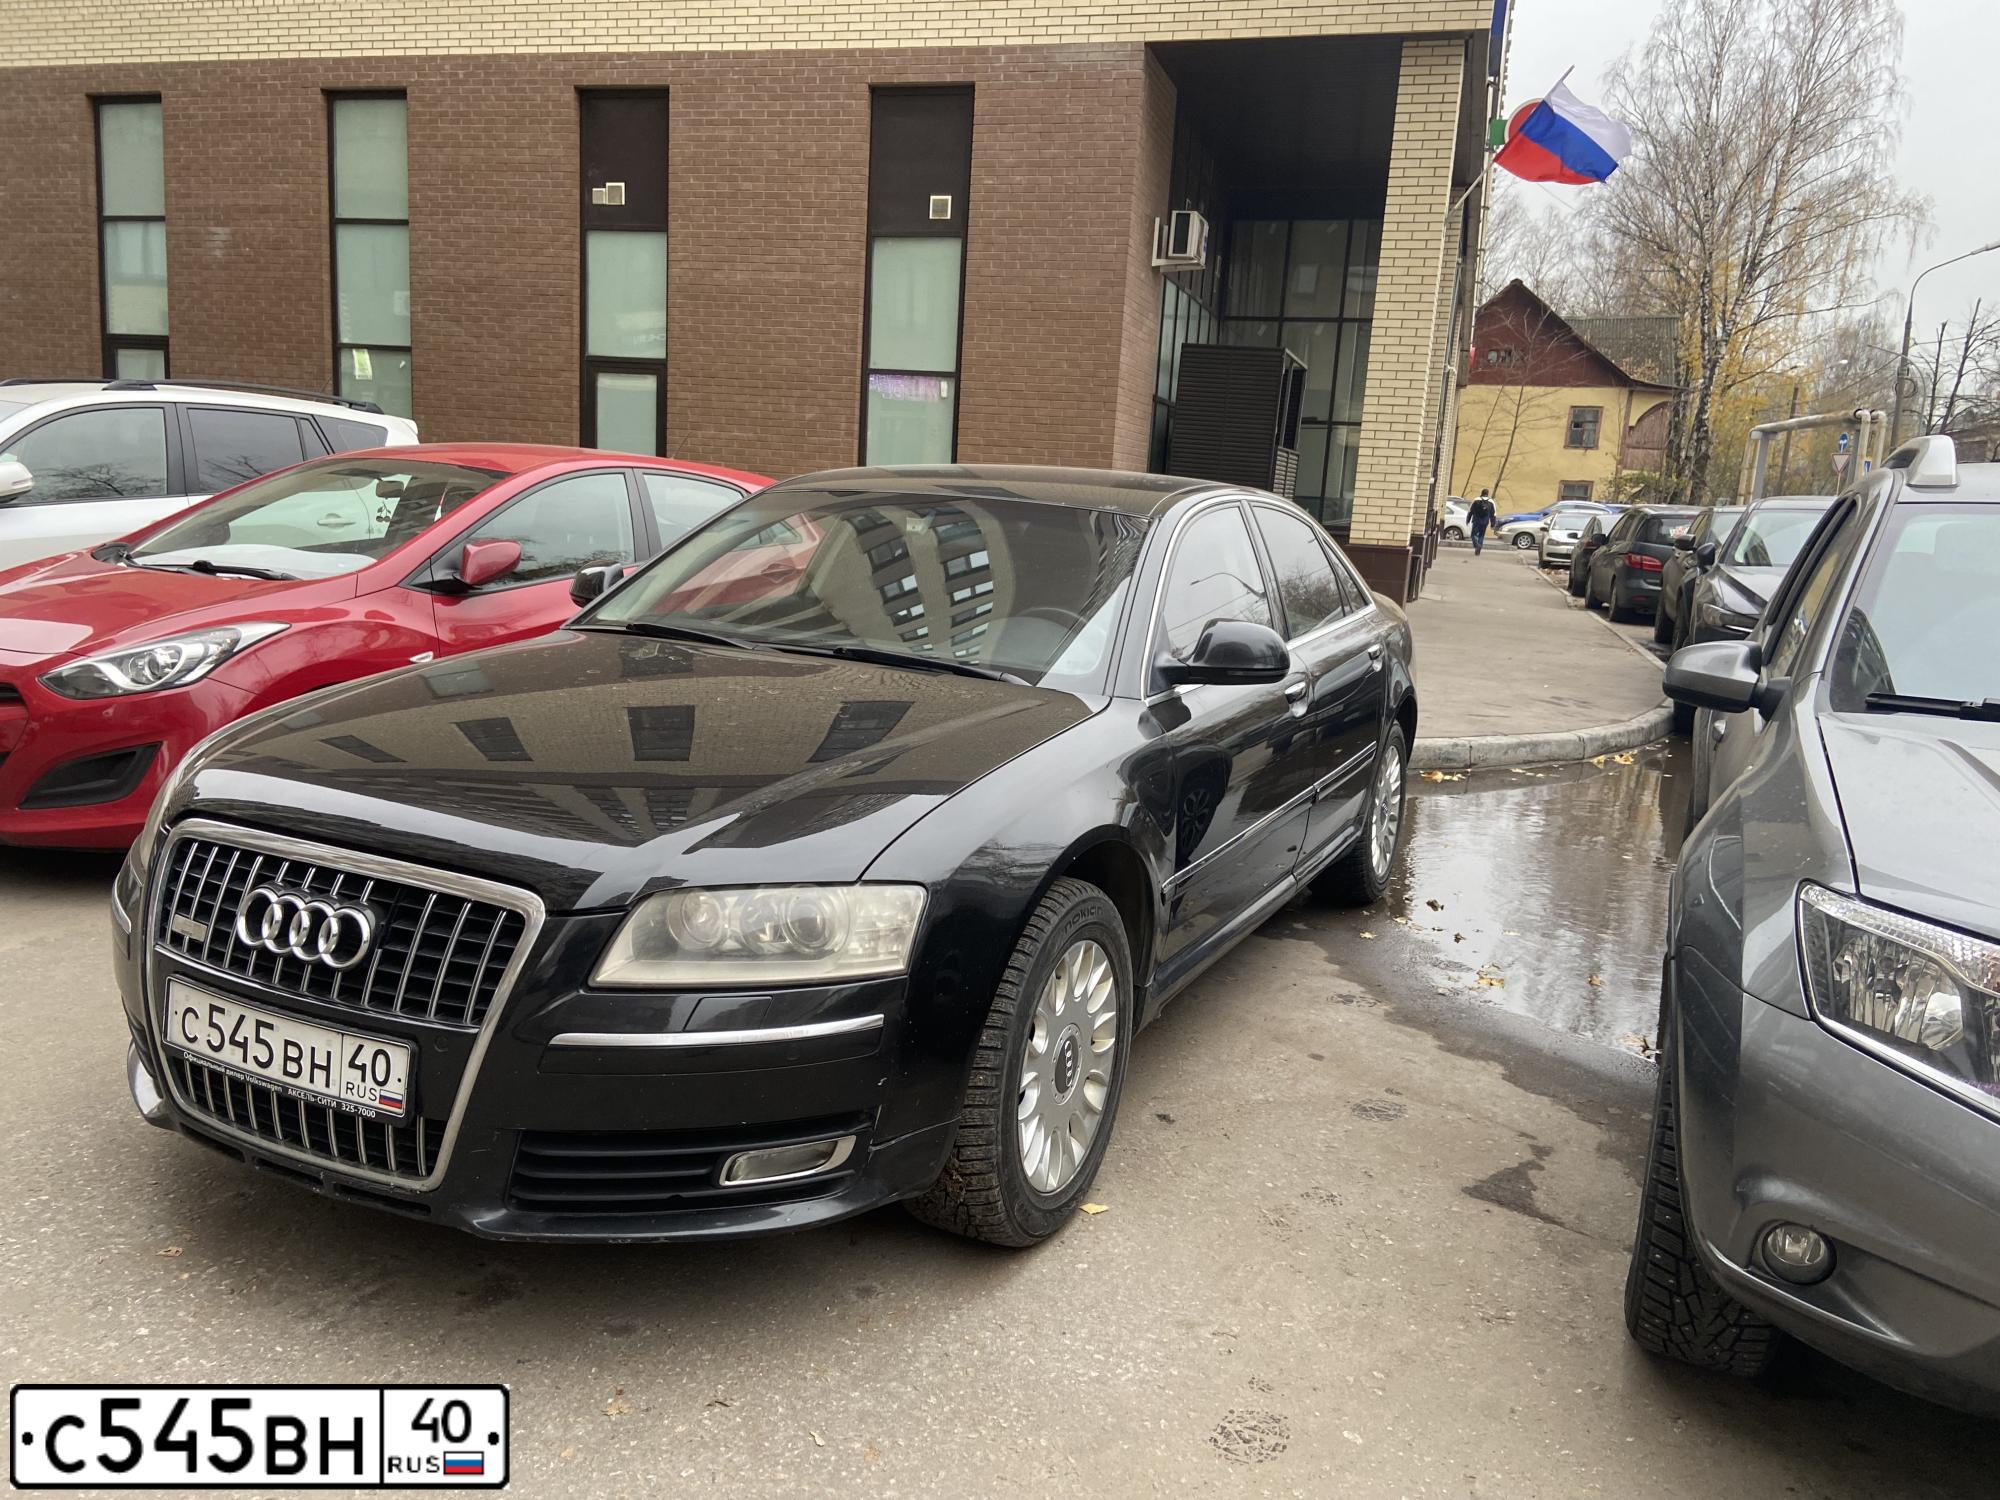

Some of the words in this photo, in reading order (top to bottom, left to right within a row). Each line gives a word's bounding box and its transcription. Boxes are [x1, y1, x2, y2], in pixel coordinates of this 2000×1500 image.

[181, 1003, 332, 1089] С545ВН
[348, 1043, 392, 1087] 40
[245, 1073, 283, 1093] Volkswagen
[341, 1103, 376, 1119] 325-7000
[345, 1081, 378, 1102] RUS
